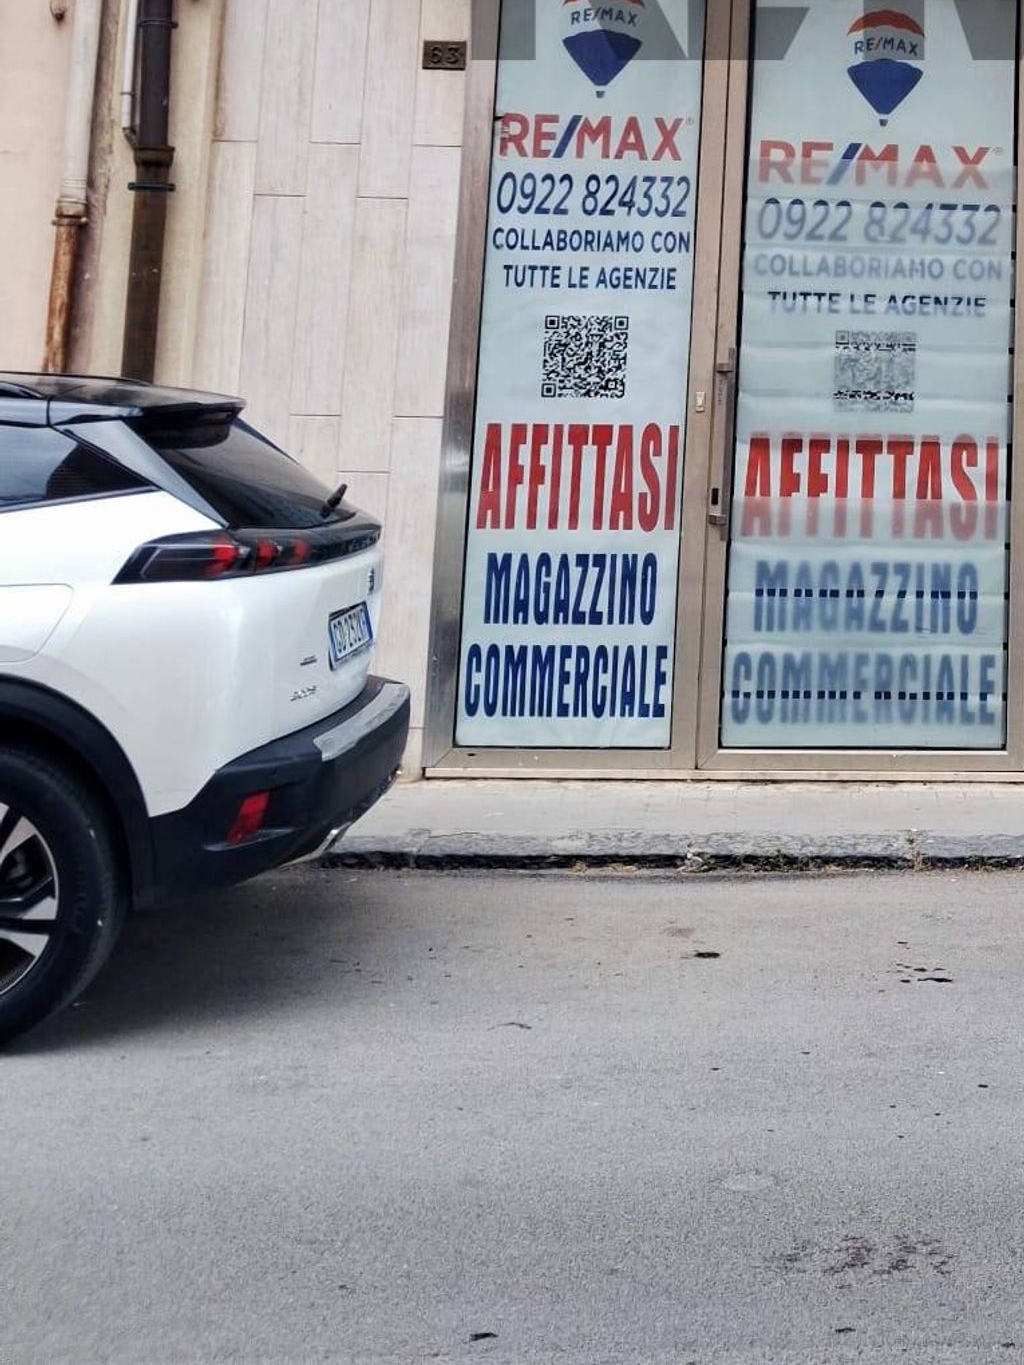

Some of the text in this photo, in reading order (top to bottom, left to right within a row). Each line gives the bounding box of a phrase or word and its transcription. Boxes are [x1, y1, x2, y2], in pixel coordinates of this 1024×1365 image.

[571, 5, 638, 27] RE/MAX
[853, 36, 919, 57] RE/MAX
[500, 113, 683, 161] RE/MAX
[759, 141, 988, 188] RE/MAX
[497, 172, 690, 217] 0922 824332
[493, 228, 690, 253] COLLABORIAMO CON
[759, 197, 1000, 243] 0922 824332
[503, 265, 676, 289] TUTTE LE AGENZIE
[753, 250, 1002, 281] COLLABORIAMO CON
[768, 291, 986, 318] TUTTE LE AGENZIE
[477, 421, 678, 532] AFFITTASI
[741, 432, 999, 541] AFFITTASI
[484, 553, 657, 625] MAGAZZINO
[755, 562, 978, 634] MAGAZZINO
[465, 644, 668, 718] COMMERCIALE
[732, 654, 994, 724] COMMERCIALE
